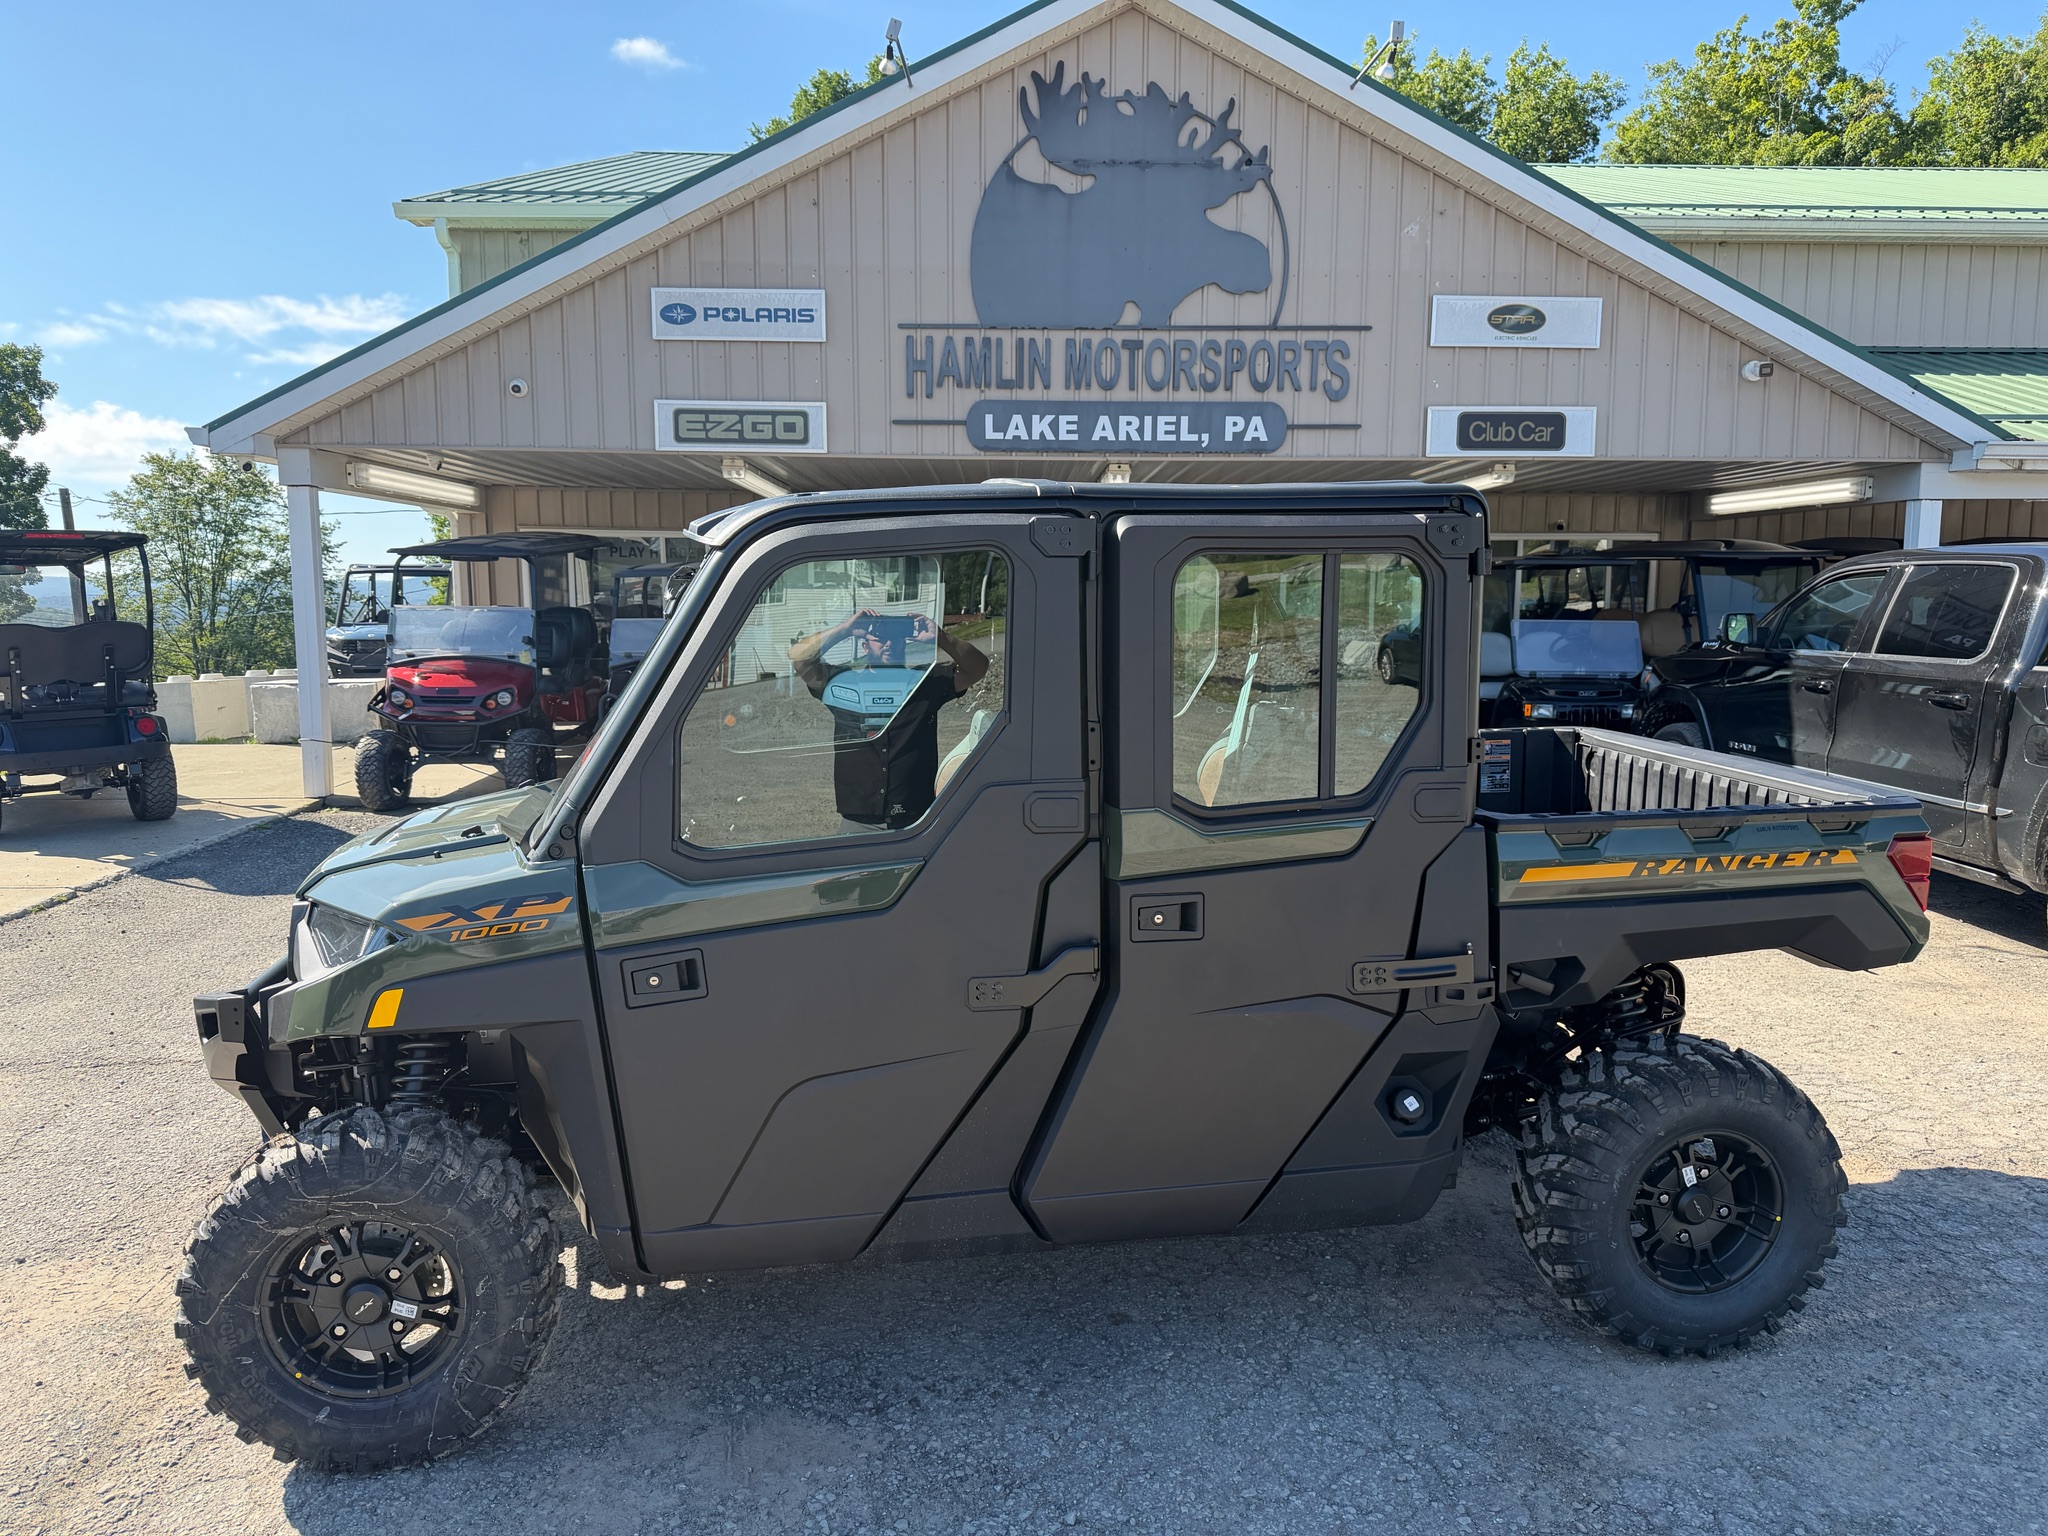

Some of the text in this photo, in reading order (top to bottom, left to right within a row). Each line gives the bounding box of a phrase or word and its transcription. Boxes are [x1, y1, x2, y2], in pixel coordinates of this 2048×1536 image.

[703, 307, 815, 323] POLARIS
[1491, 314, 1536, 324] STAR
[906, 334, 1350, 402] HAMLIN MOTORSPORTS
[984, 413, 1269, 447] LAKE ARIEL, PA
[1469, 421, 1555, 442] Club Car
[609, 546, 705, 559] PLAY HRDER
[1629, 848, 1841, 879] RANGER
[421, 891, 568, 930] XP
[449, 918, 550, 942] 1000
